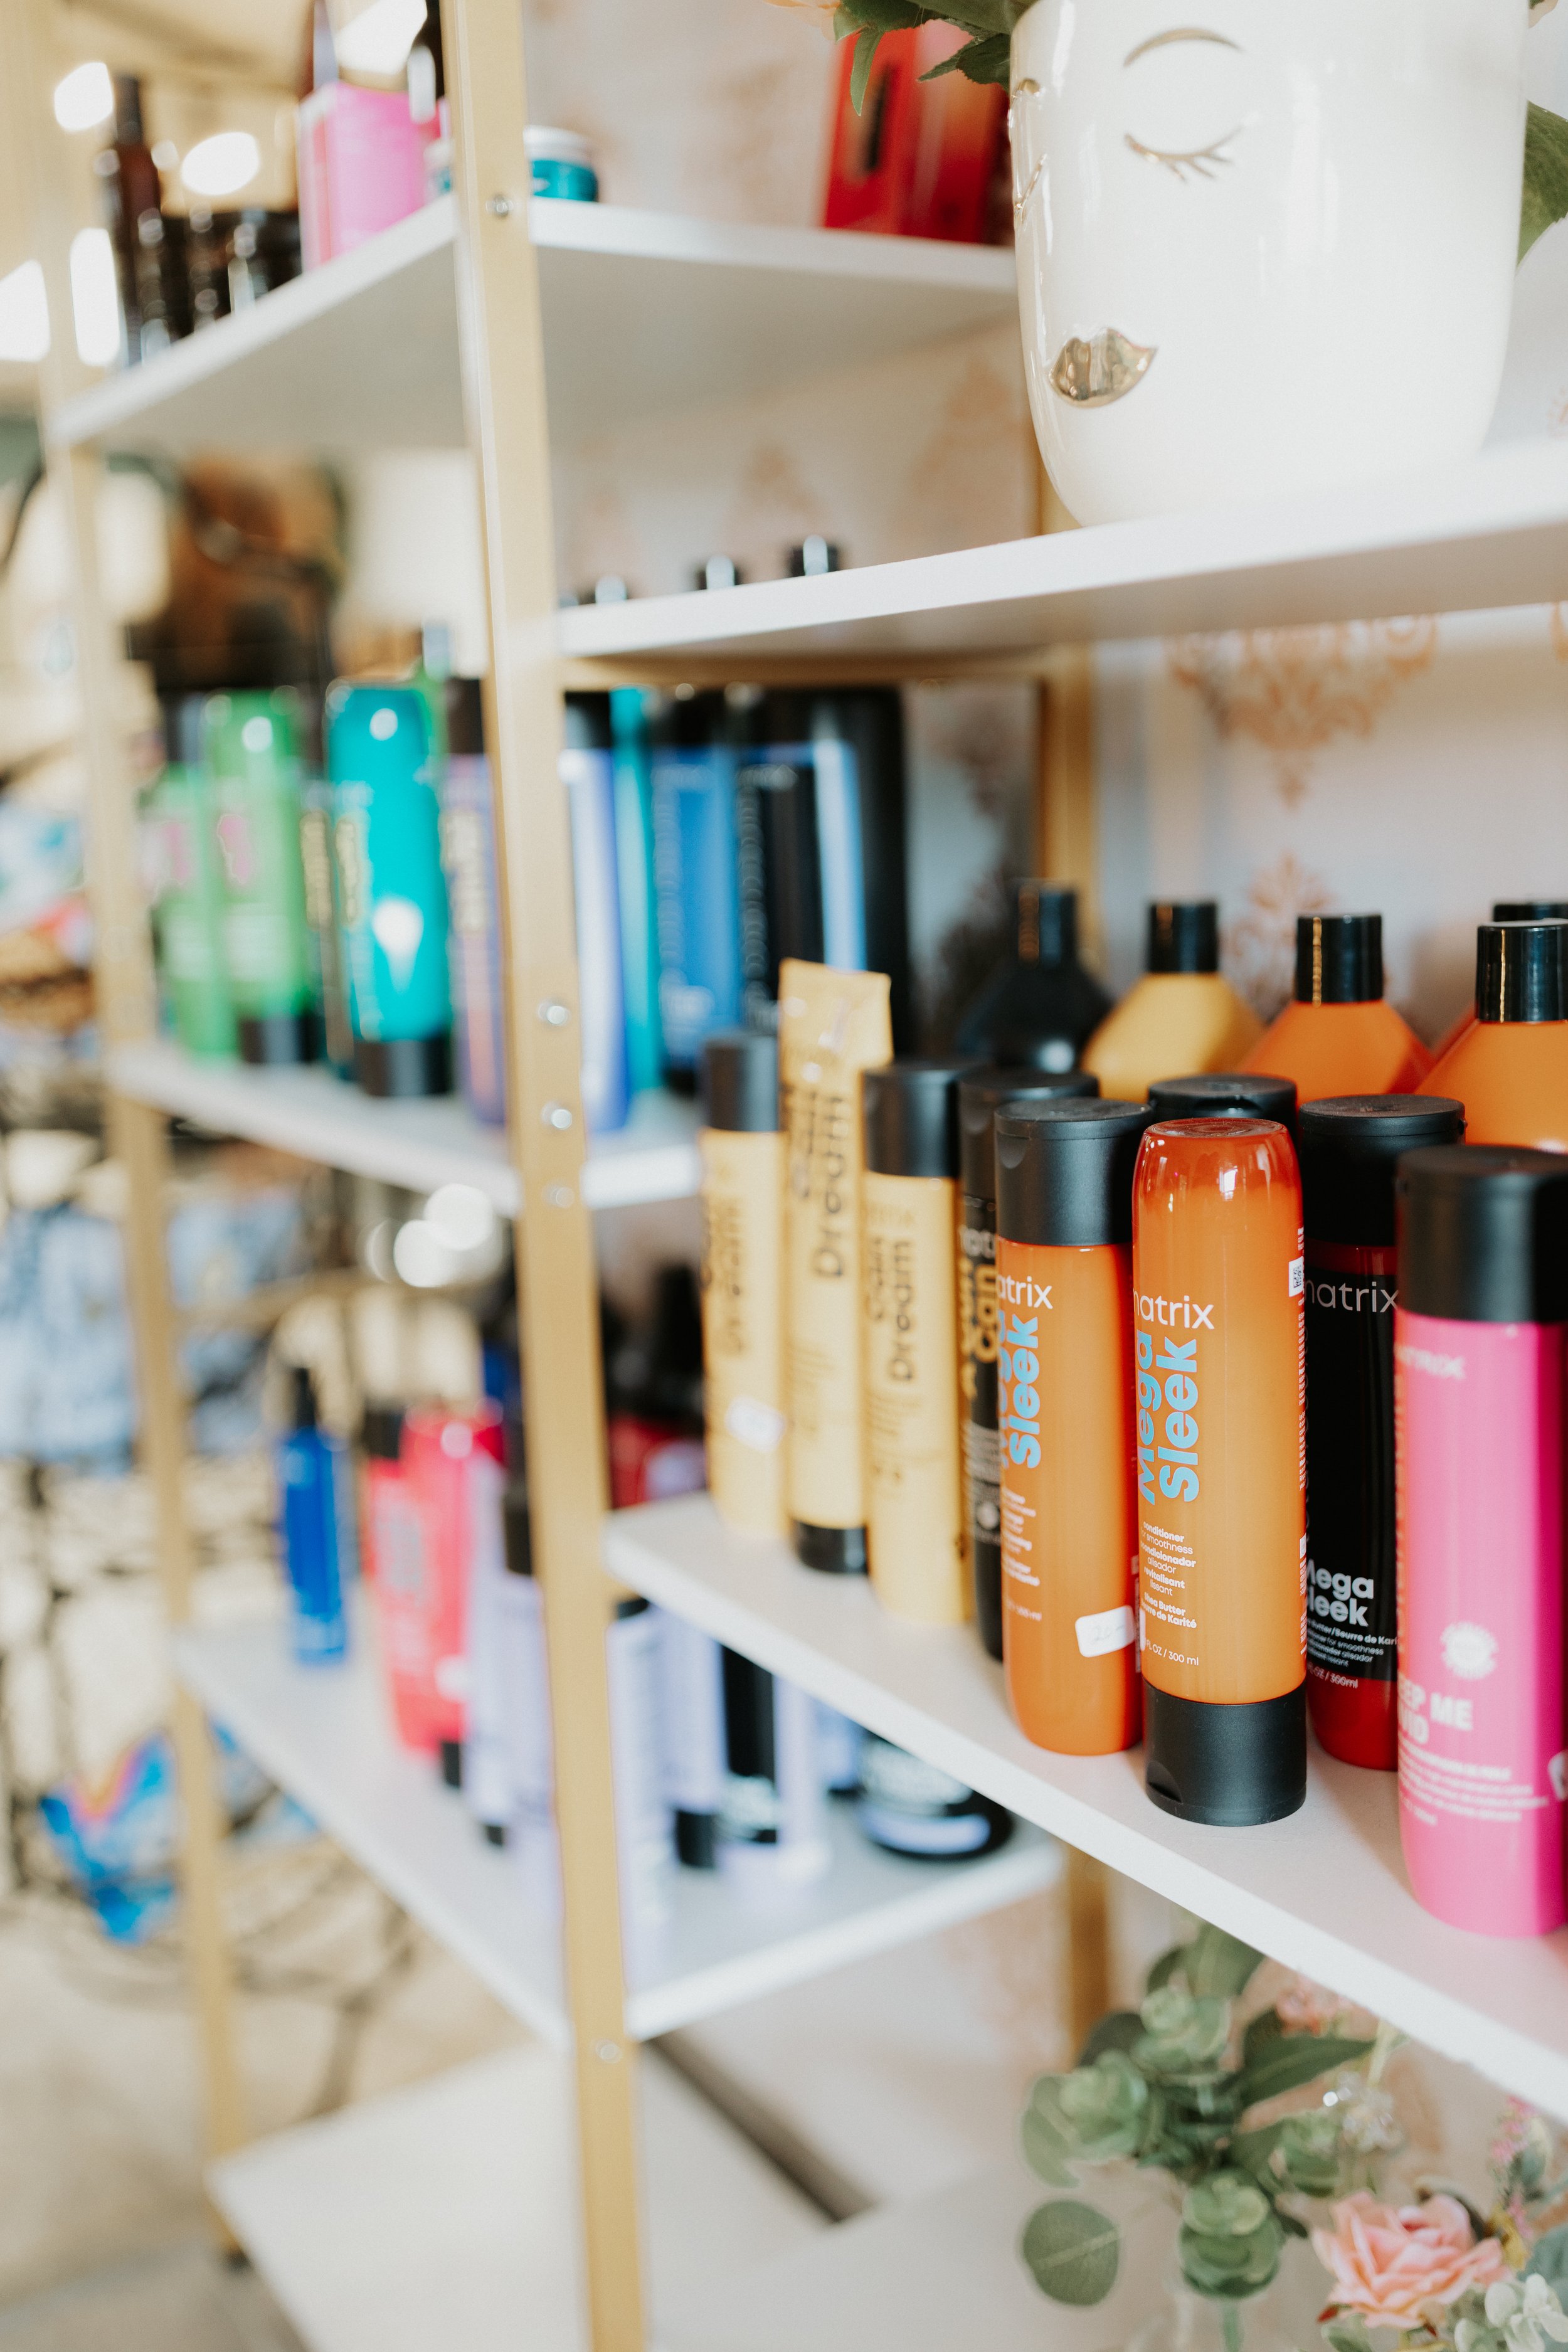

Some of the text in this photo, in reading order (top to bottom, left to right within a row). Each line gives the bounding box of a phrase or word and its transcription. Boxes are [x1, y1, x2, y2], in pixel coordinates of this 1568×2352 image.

[996, 1275, 1054, 1309] atrix
[1006, 1313, 1042, 1469] Sleek
[1137, 1329, 1162, 1505] Mega
[1156, 1336, 1199, 1503] Sleek
[1143, 1521, 1184, 1542] conditioner
[1147, 1534, 1193, 1555] smoothness
[1147, 1557, 1177, 1574] alisador
[1144, 1567, 1185, 1589] revitalisant
[1150, 1579, 1173, 1596] lissant
[1158, 1600, 1186, 1616] Butter
[1308, 1586, 1369, 1627] leek
[1157, 1610, 1167, 1621] de
[1167, 1614, 1197, 1629] Karité
[1152, 1644, 1162, 1656] OZ
[1168, 1651, 1185, 1663] 300
[1187, 1656, 1199, 1666] ml
[1431, 1692, 1473, 1732] ME
